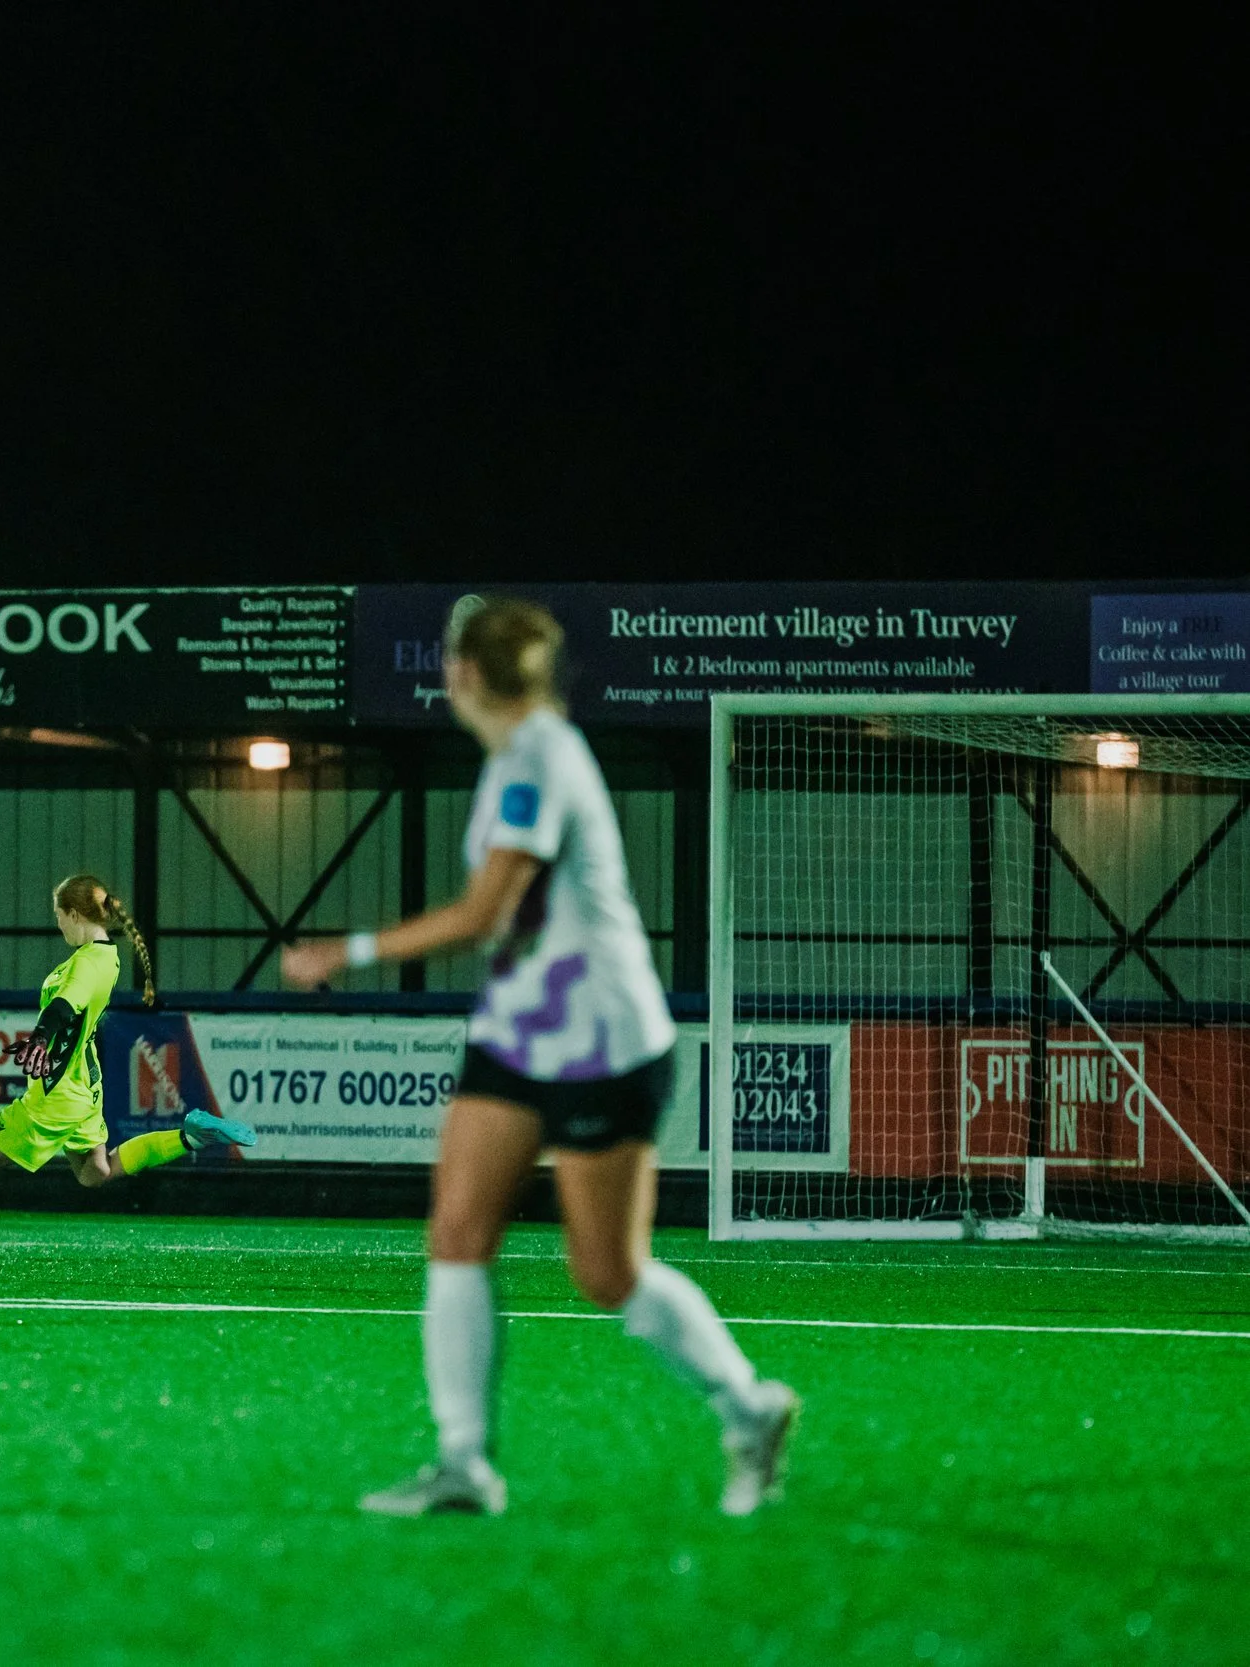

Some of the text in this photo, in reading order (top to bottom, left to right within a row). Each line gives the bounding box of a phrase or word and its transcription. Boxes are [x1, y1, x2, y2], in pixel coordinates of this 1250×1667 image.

[240, 597, 336, 614] Quality Repairs
[221, 617, 336, 634] Bespoke Jewellery
[610, 607, 1017, 648] Retirement village in Turvey
[1122, 616, 1223, 639] Enjoy a FREE
[177, 637, 336, 653] Remounts & Re-modelling
[1099, 642, 1246, 662] Coffee & cake with
[200, 656, 336, 673] Stones Supplied & Set
[652, 655, 975, 682] 1 & 2 Bedroom apartments available
[269, 676, 336, 690] Valuations
[1119, 676, 1128, 689] a
[1131, 672, 1183, 693] village
[245, 696, 336, 712] Watch Repairs
[604, 685, 662, 704] Arrange
[664, 690, 673, 701] a
[675, 687, 707, 701] tour
[210, 1038, 458, 1055] Electrical Mechanical Building Security
[230, 1068, 456, 1106] 01767 600259
[987, 1054, 1119, 1103] PITHING
[733, 1088, 817, 1122] 02043
[255, 1123, 440, 1139] www.harrisonselectrical.co.
[1050, 1104, 1078, 1152] IN
